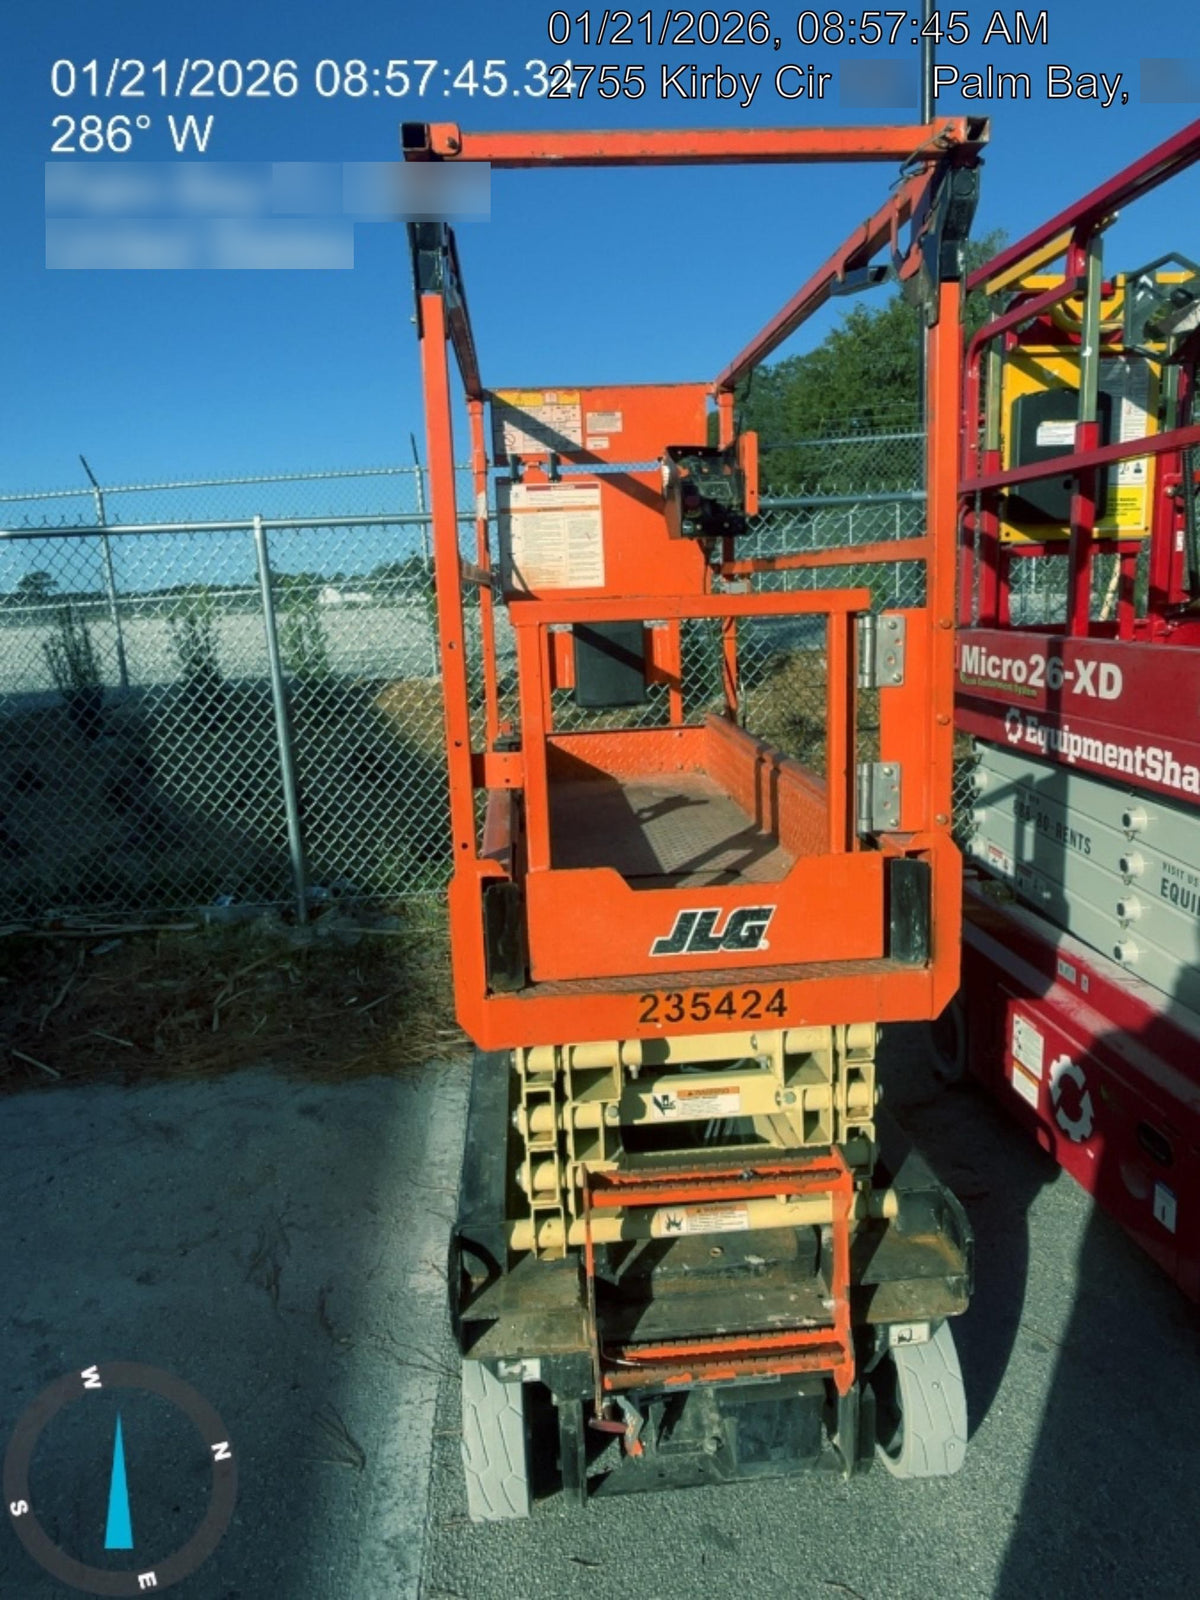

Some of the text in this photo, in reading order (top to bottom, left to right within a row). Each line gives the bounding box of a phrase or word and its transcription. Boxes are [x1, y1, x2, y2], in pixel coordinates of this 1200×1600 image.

[961, 644, 1123, 700] Micro26-XD
[1025, 715, 1200, 796] EquipmentSha
[649, 905, 777, 956] JLG
[638, 987, 788, 1023] 235424
